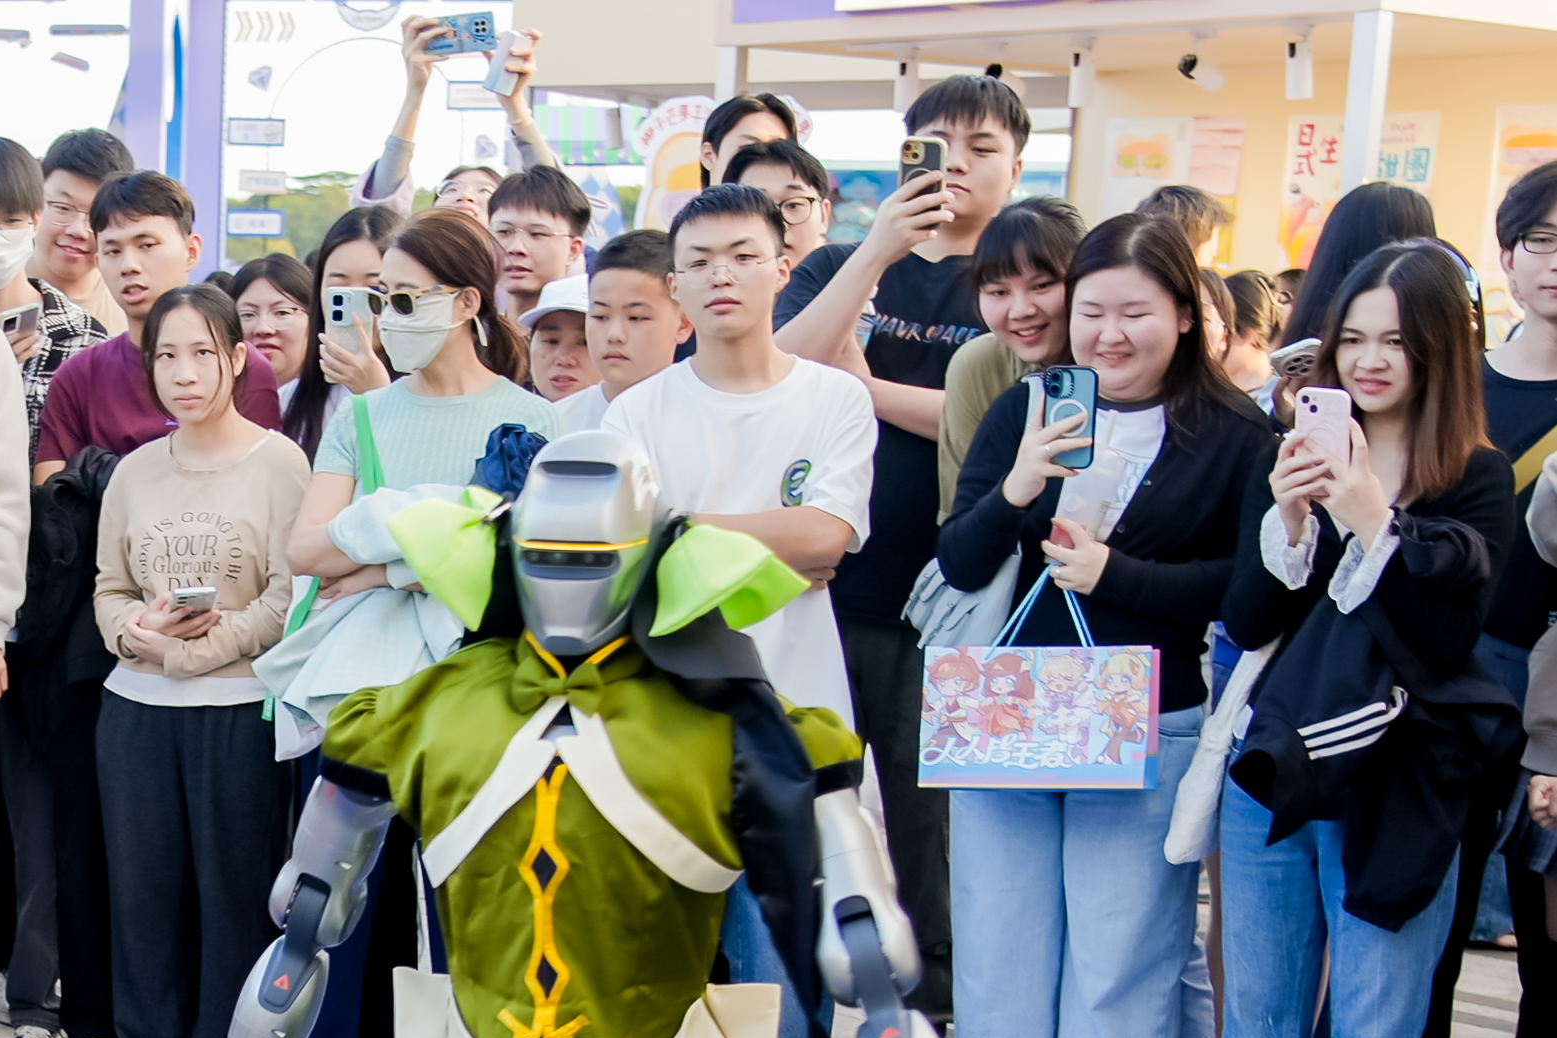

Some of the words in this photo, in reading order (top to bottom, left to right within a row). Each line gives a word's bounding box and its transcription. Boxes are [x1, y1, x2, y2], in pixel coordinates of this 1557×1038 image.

[153, 518, 174, 533] IS
[181, 511, 234, 534] GOING
[163, 534, 219, 556] YOUR
[153, 555, 221, 574] Glorious
